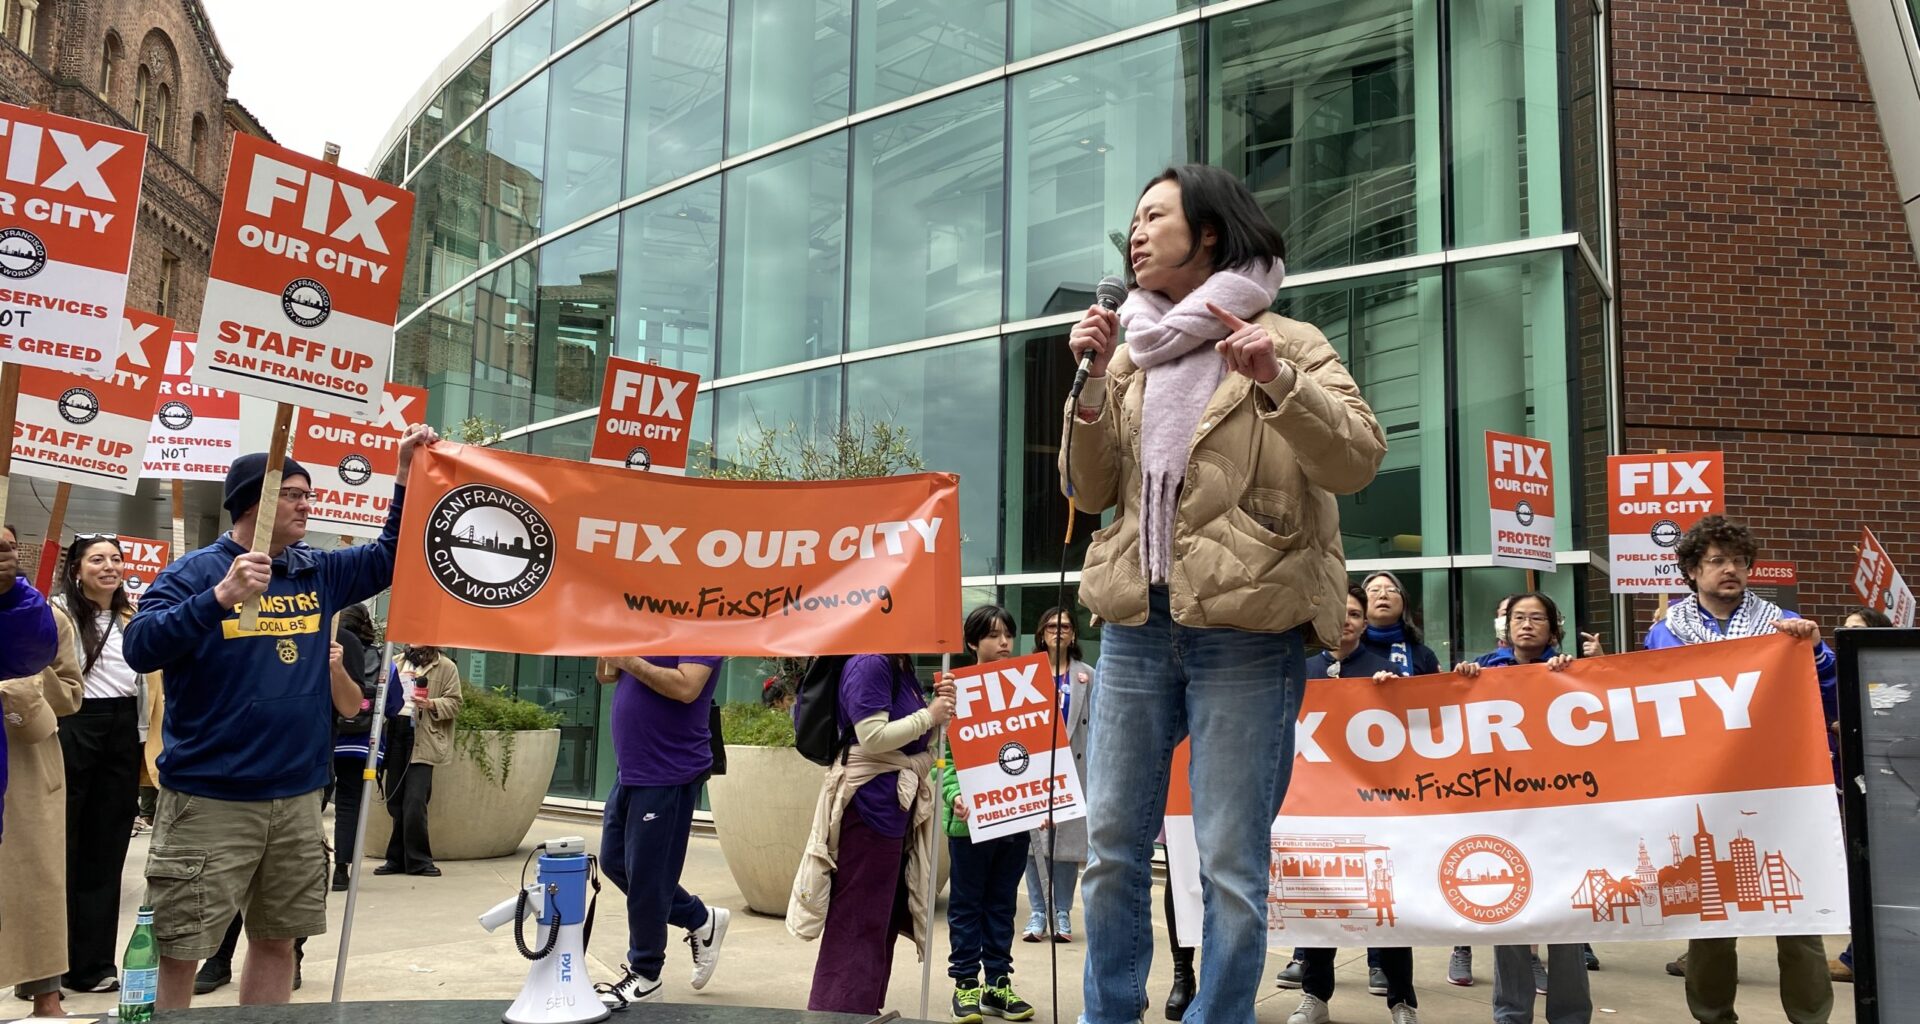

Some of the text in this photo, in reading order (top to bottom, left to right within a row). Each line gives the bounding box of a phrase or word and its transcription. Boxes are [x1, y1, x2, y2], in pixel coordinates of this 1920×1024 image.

[0, 118, 124, 202] IX
[24, 198, 115, 233] CITY
[245, 153, 398, 256] FIX
[4, 229, 45, 256] FRANCISCO
[237, 224, 388, 285] OUR CITY
[3, 261, 42, 277] WORKERS
[0, 288, 108, 319] SERVICES
[285, 279, 329, 306] SAN FRANCISCO
[0, 309, 32, 328] OT
[284, 302, 328, 326] CITY WORKERS
[18, 337, 102, 363] GREED
[217, 320, 326, 363] STAFF
[330, 347, 373, 374] UP
[213, 349, 257, 371] SAN
[260, 360, 368, 396] FRANCISCO
[611, 369, 690, 420] FIX
[13, 421, 133, 458] STAFF UP
[168, 436, 232, 447] SERVICES
[308, 424, 357, 446] OUR
[606, 418, 682, 442] OUR CITY
[12, 444, 128, 474] AN FRANCISCO
[142, 462, 230, 474] VATE GREED
[161, 447, 189, 460] NOT
[1493, 440, 1548, 479] FIX
[1495, 478, 1549, 497] OUR CITY
[1620, 460, 1713, 496] FIX
[307, 506, 323, 516] AN
[1619, 500, 1713, 515] OUR CITY
[120, 541, 163, 563] FIX
[575, 516, 943, 568] FIX OUR CITY
[1498, 530, 1551, 548] PROTECT
[1498, 546, 1552, 559] PUBLIC SERVICES
[136, 564, 160, 573] CITY
[1616, 553, 1658, 562] PUBLIC
[1655, 563, 1680, 576] NOT
[1855, 536, 1879, 599] FIX
[434, 549, 545, 600] CITY WORKERS
[1617, 578, 1672, 586] PRIVATE
[1756, 567, 1794, 578] ACCESS
[623, 584, 893, 619] www.FixSFNow.org
[954, 663, 1048, 719] FIX
[959, 709, 1050, 742] OUR CITY
[1345, 699, 1533, 762] OUR
[1546, 671, 1762, 747] CITY
[973, 774, 1067, 810] PROTECT
[1357, 766, 1598, 803] www.FixSFNow.org
[976, 793, 1074, 824] PUBLIC SERVCES
[1443, 840, 1525, 876] SAN FRANCISCO
[1448, 885, 1527, 918] CITY WORKERS
[561, 953, 571, 982] PYLE
[546, 994, 576, 1011] SEIU
